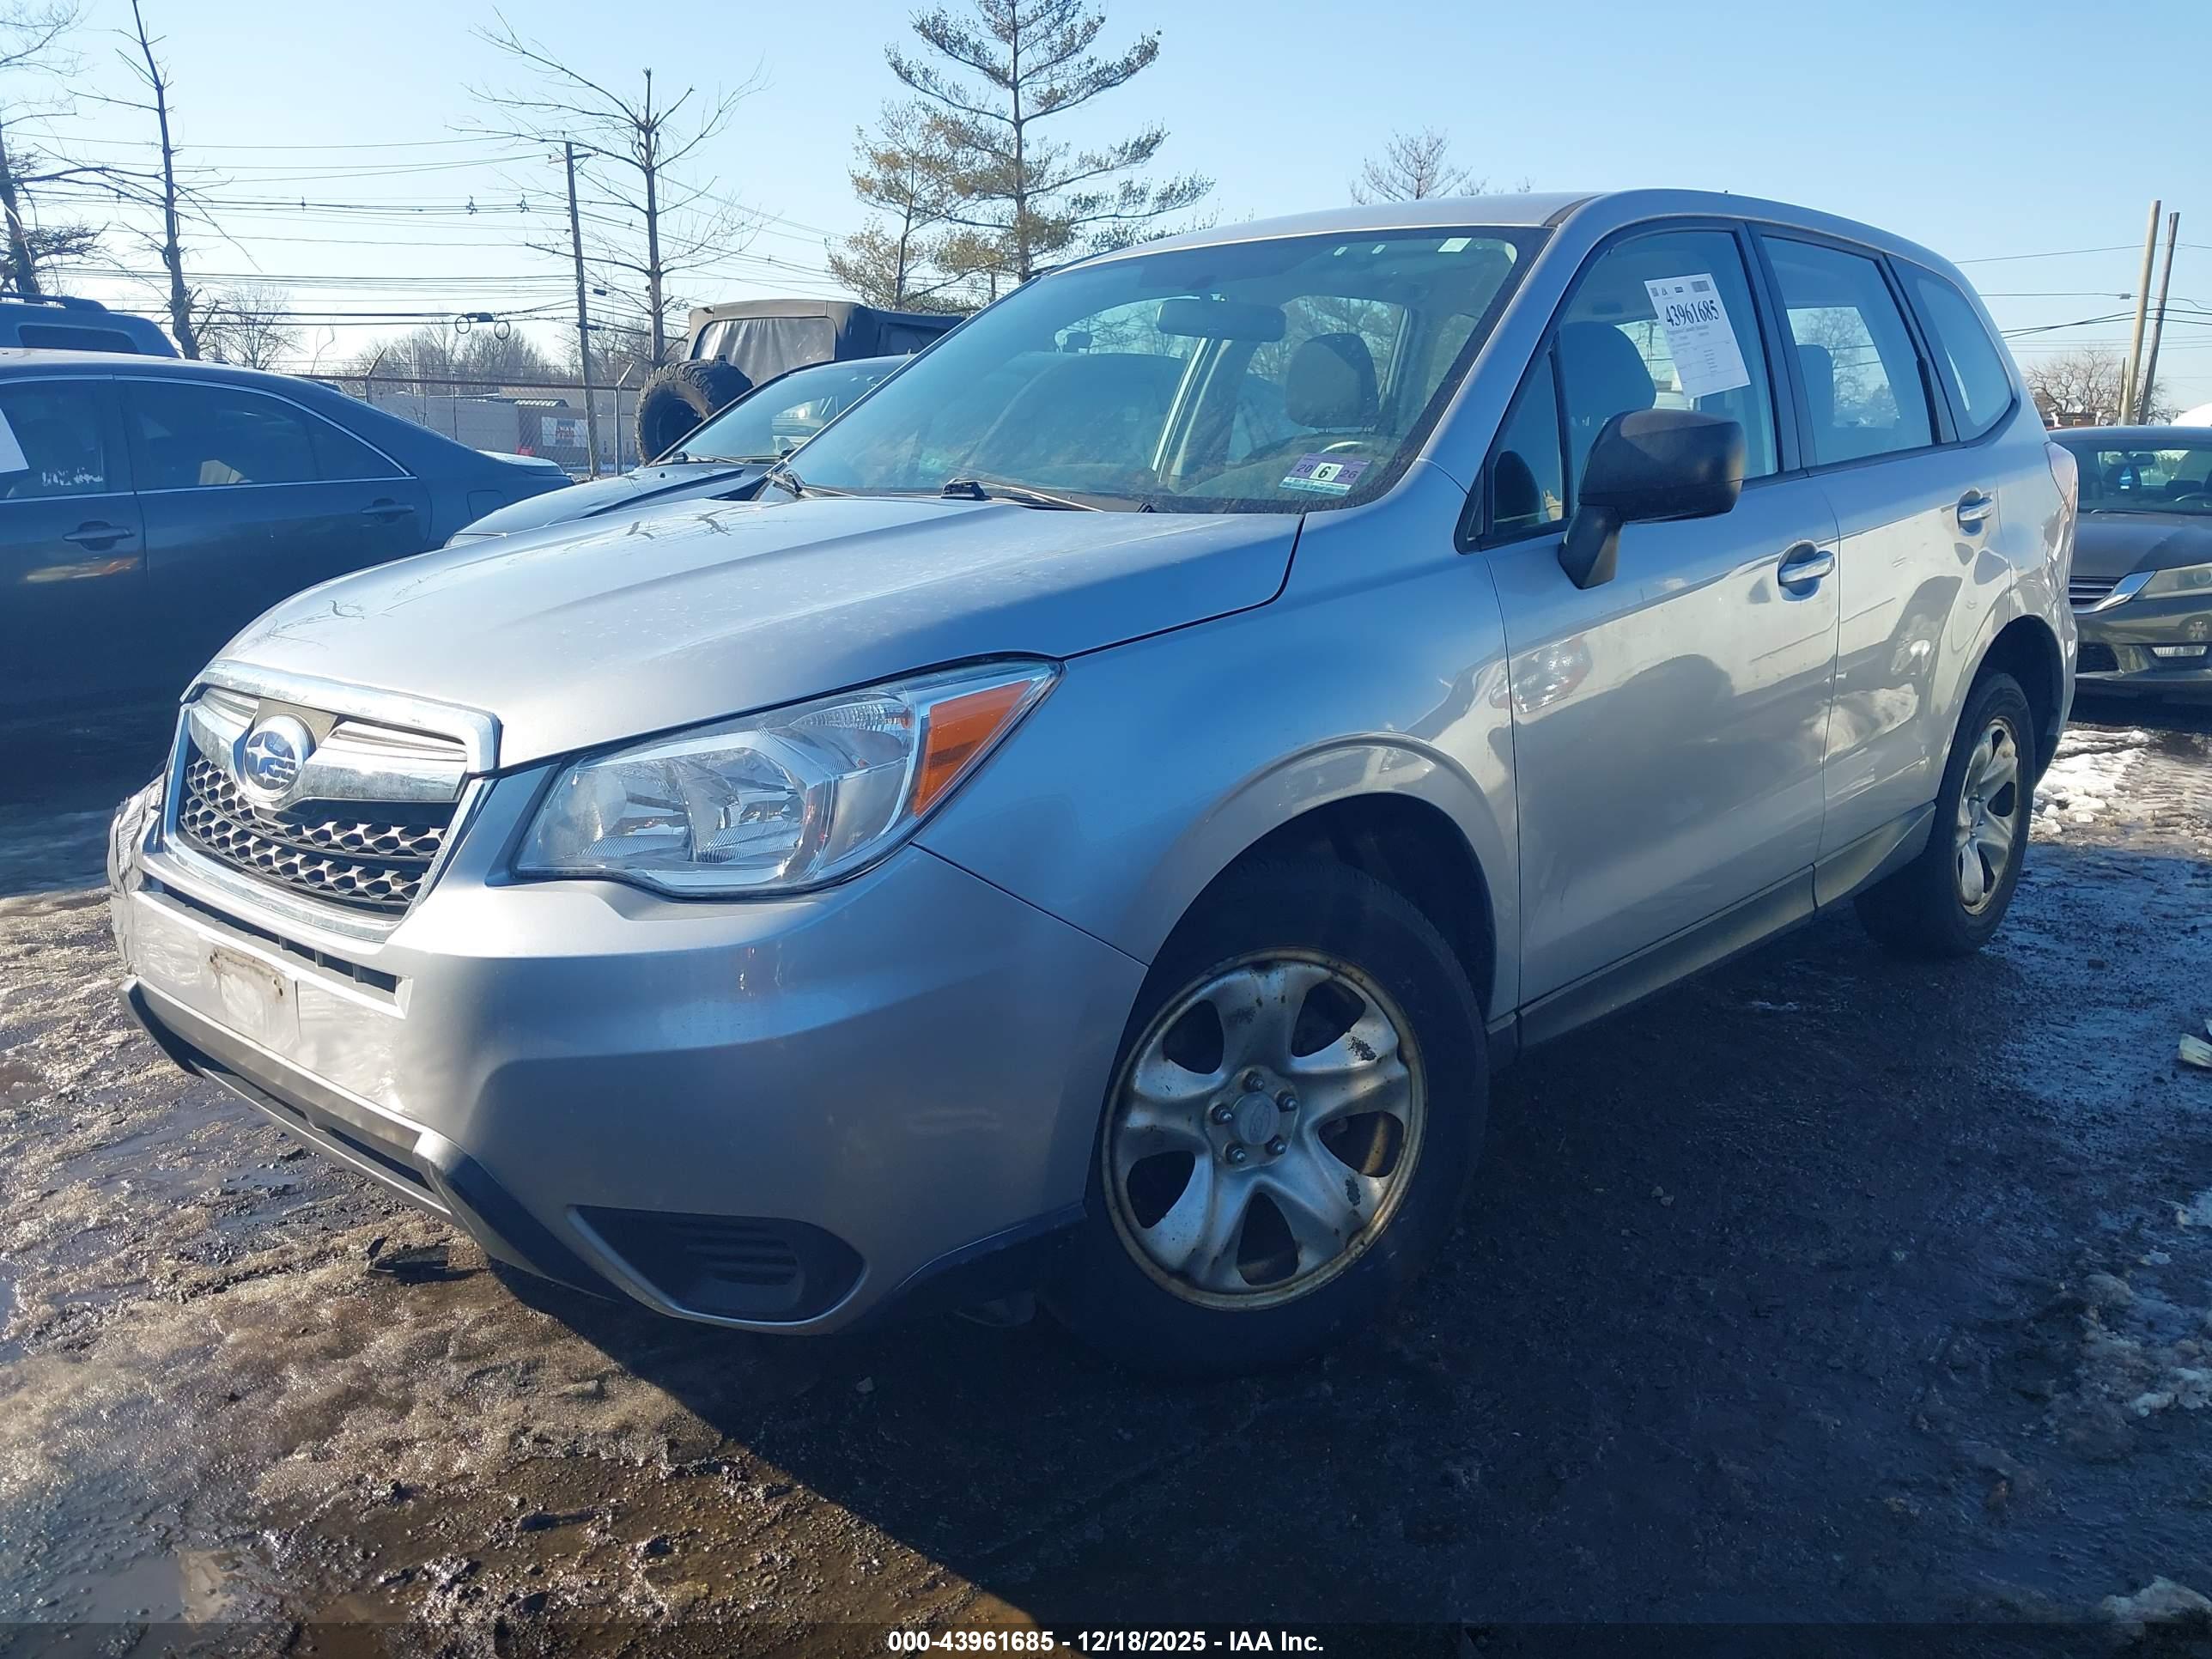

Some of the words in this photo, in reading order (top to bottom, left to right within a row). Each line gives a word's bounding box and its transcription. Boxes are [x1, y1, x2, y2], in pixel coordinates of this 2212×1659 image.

[1666, 300, 1719, 326] 43961685
[1297, 465, 1314, 473] 20
[1318, 465, 1332, 478] 6
[1340, 469, 1358, 479] 26
